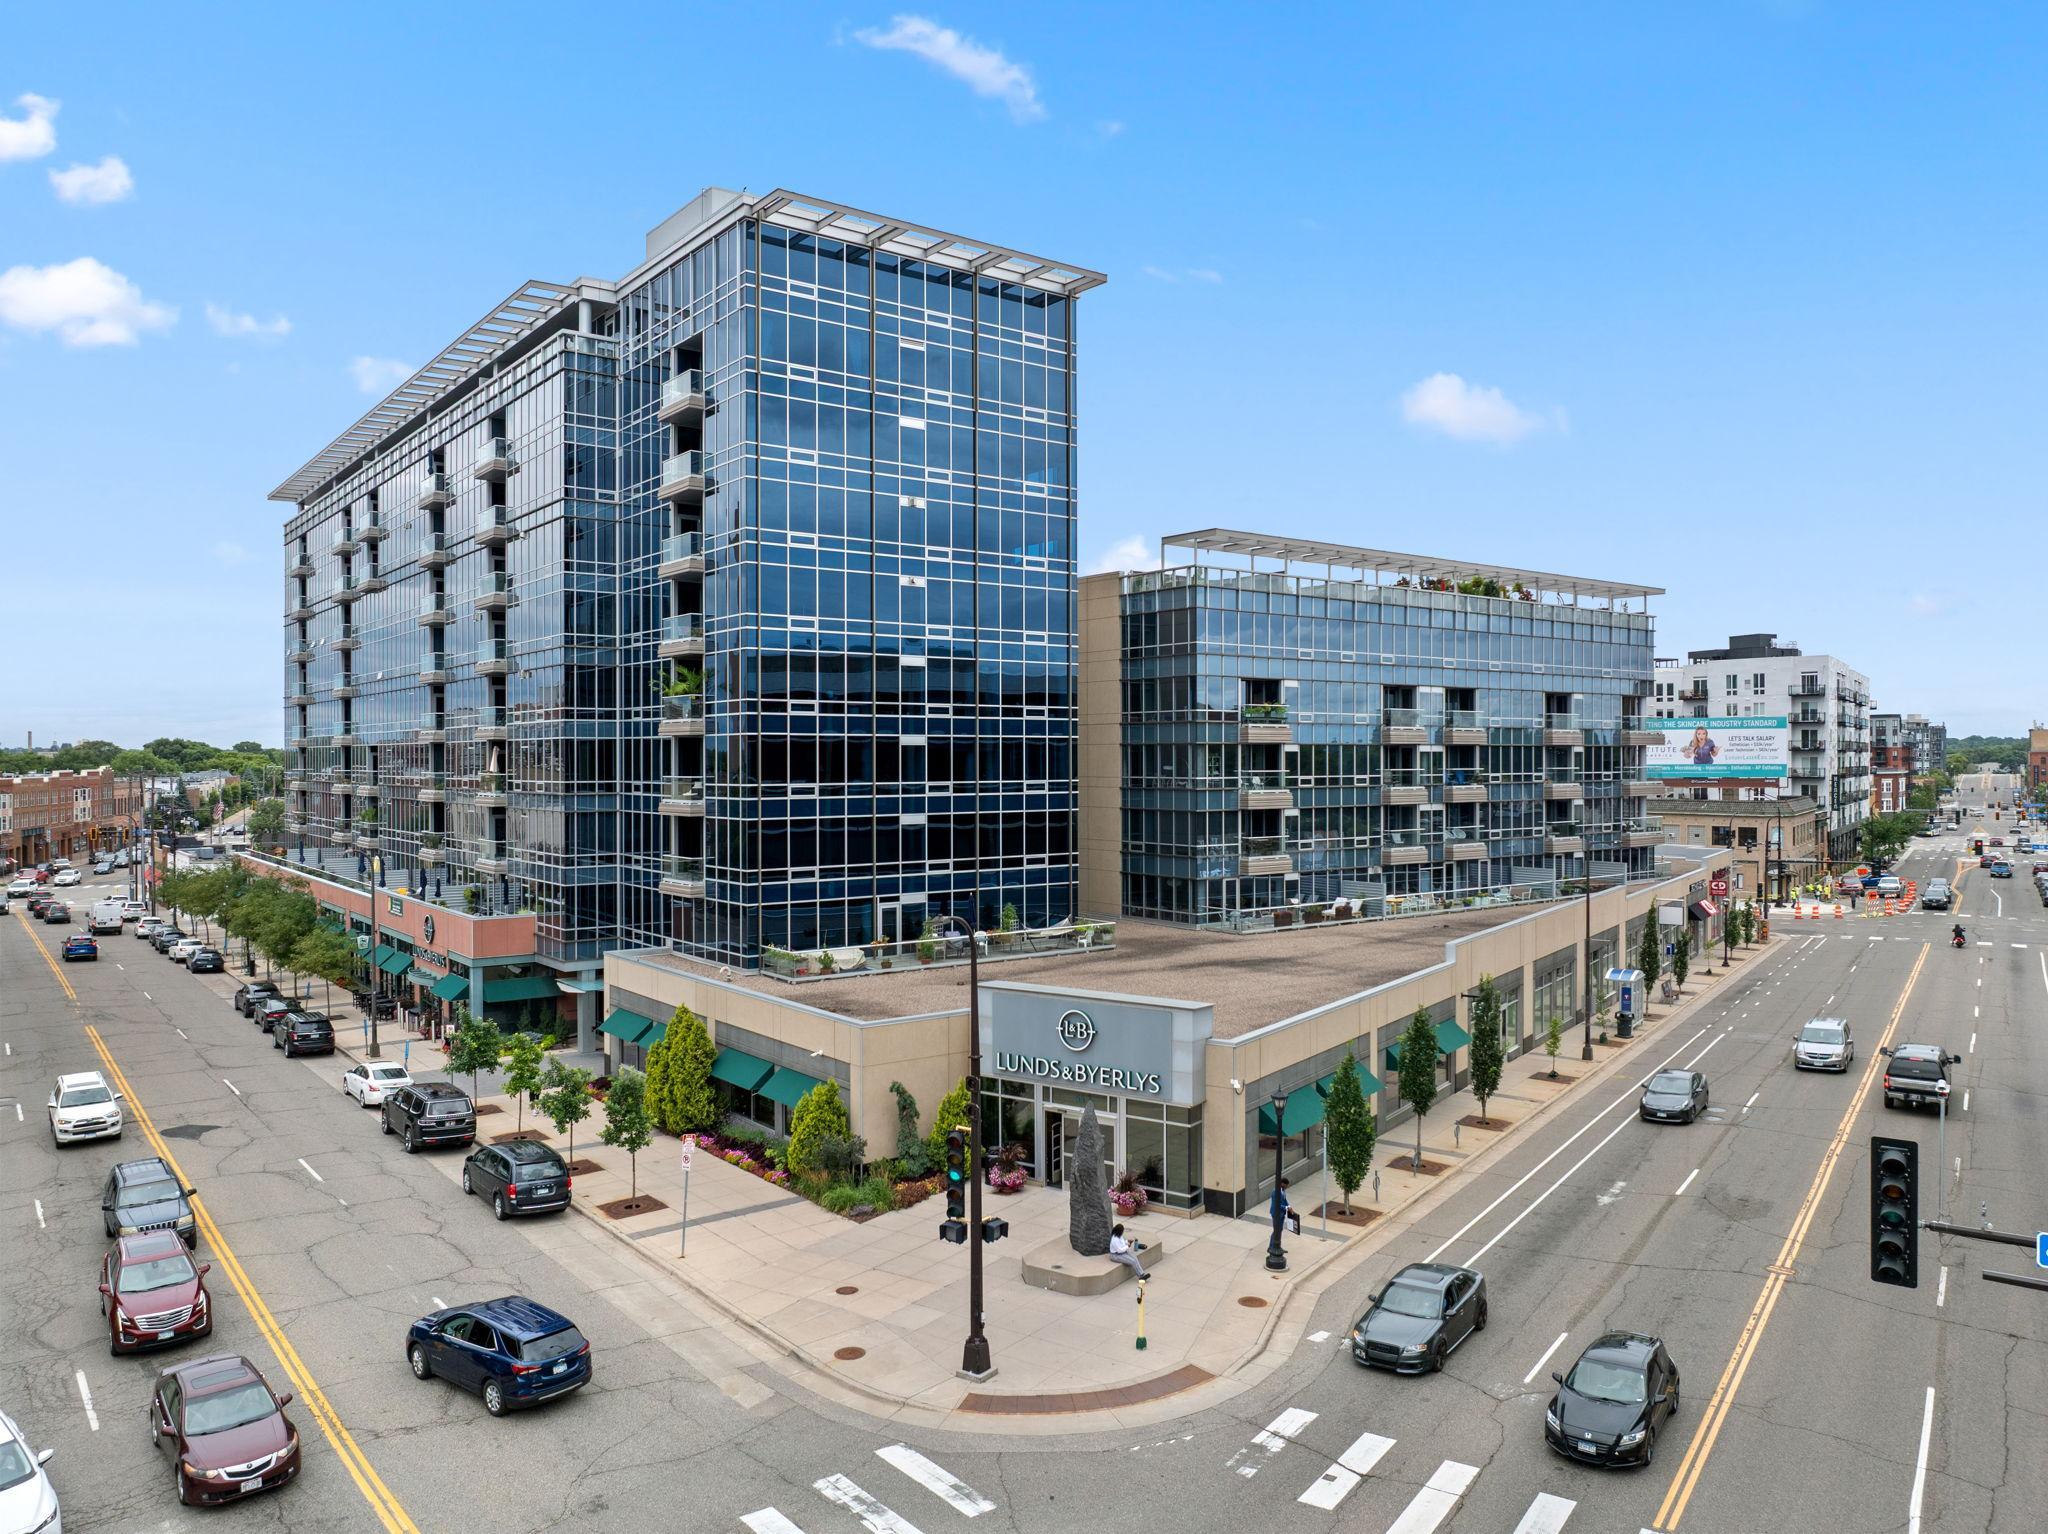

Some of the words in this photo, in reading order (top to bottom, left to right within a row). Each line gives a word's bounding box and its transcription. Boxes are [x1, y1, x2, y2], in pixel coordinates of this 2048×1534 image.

[1677, 720, 1709, 728] SKINCARE
[1710, 720, 1742, 728] INDUSTRY
[1743, 719, 1777, 727] STANDARD
[1063, 1020, 1087, 1039] L&B
[995, 1052, 1161, 1094] LUNDS&BYERLYS
